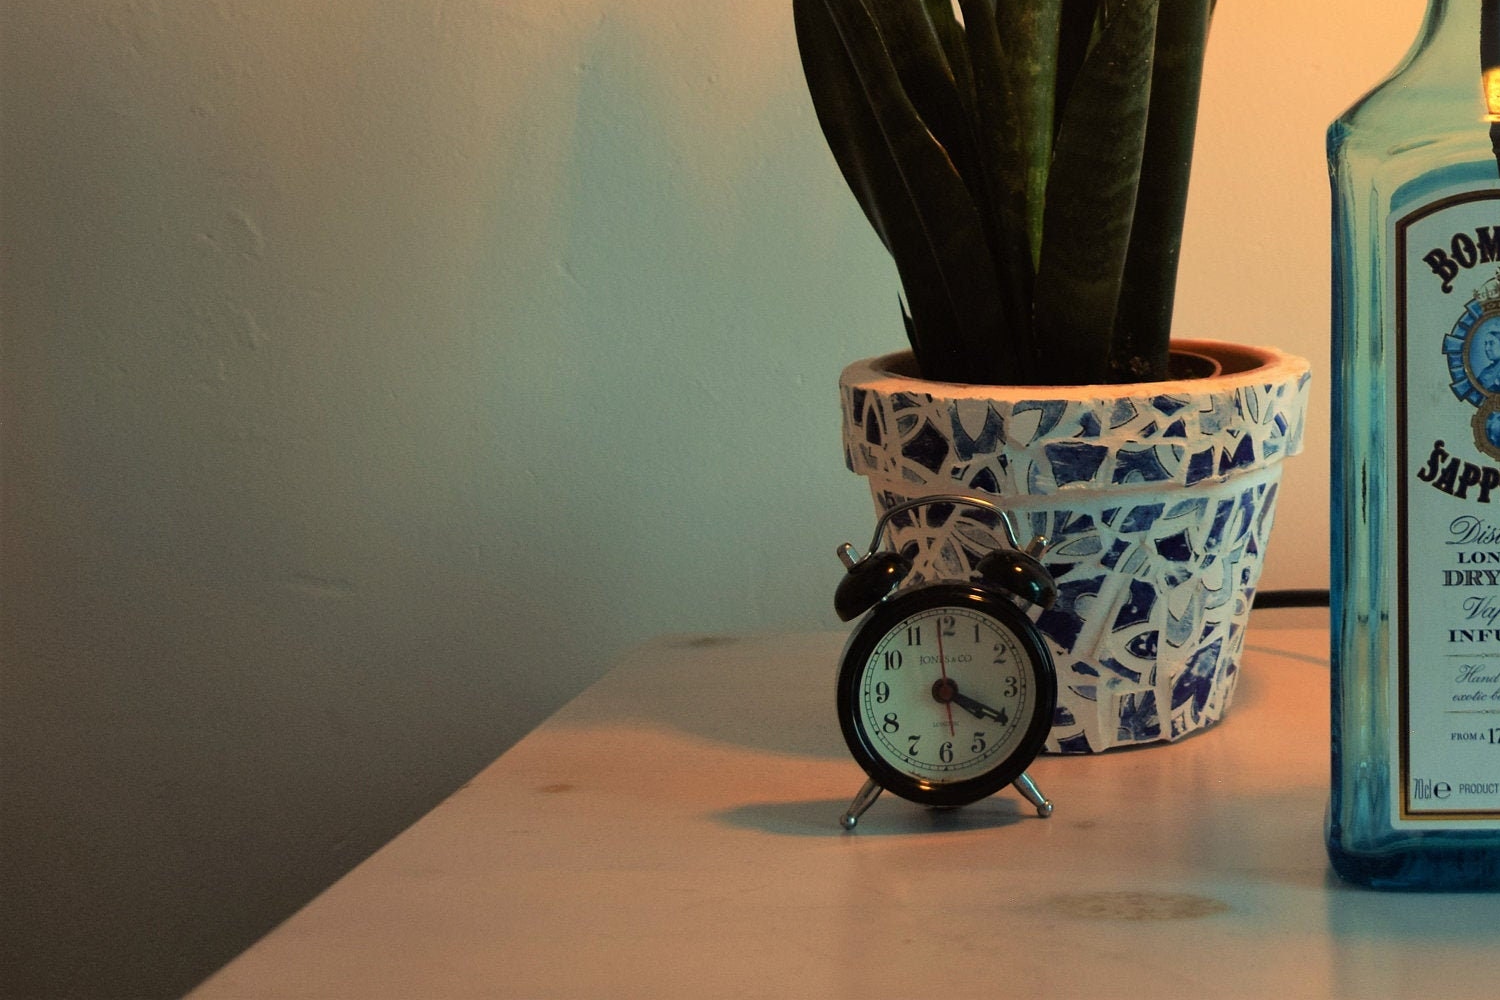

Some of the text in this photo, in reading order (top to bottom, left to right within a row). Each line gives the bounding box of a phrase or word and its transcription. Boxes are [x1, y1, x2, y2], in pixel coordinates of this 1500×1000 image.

[906, 626, 921, 646] 11
[973, 623, 980, 643] 1
[884, 650, 903, 671] 10
[992, 643, 1006, 664] 2
[875, 681, 890, 704] 9
[1003, 676, 1018, 698] 3
[1452, 689, 1488, 702] exotic
[882, 712, 900, 734] 8
[907, 735, 921, 756] 7
[970, 732, 987, 754] 5
[1450, 732, 1477, 741] FROM
[1478, 732, 1486, 741] A
[939, 742, 954, 764] 6
[1458, 783, 1500, 795] PRODUCT
